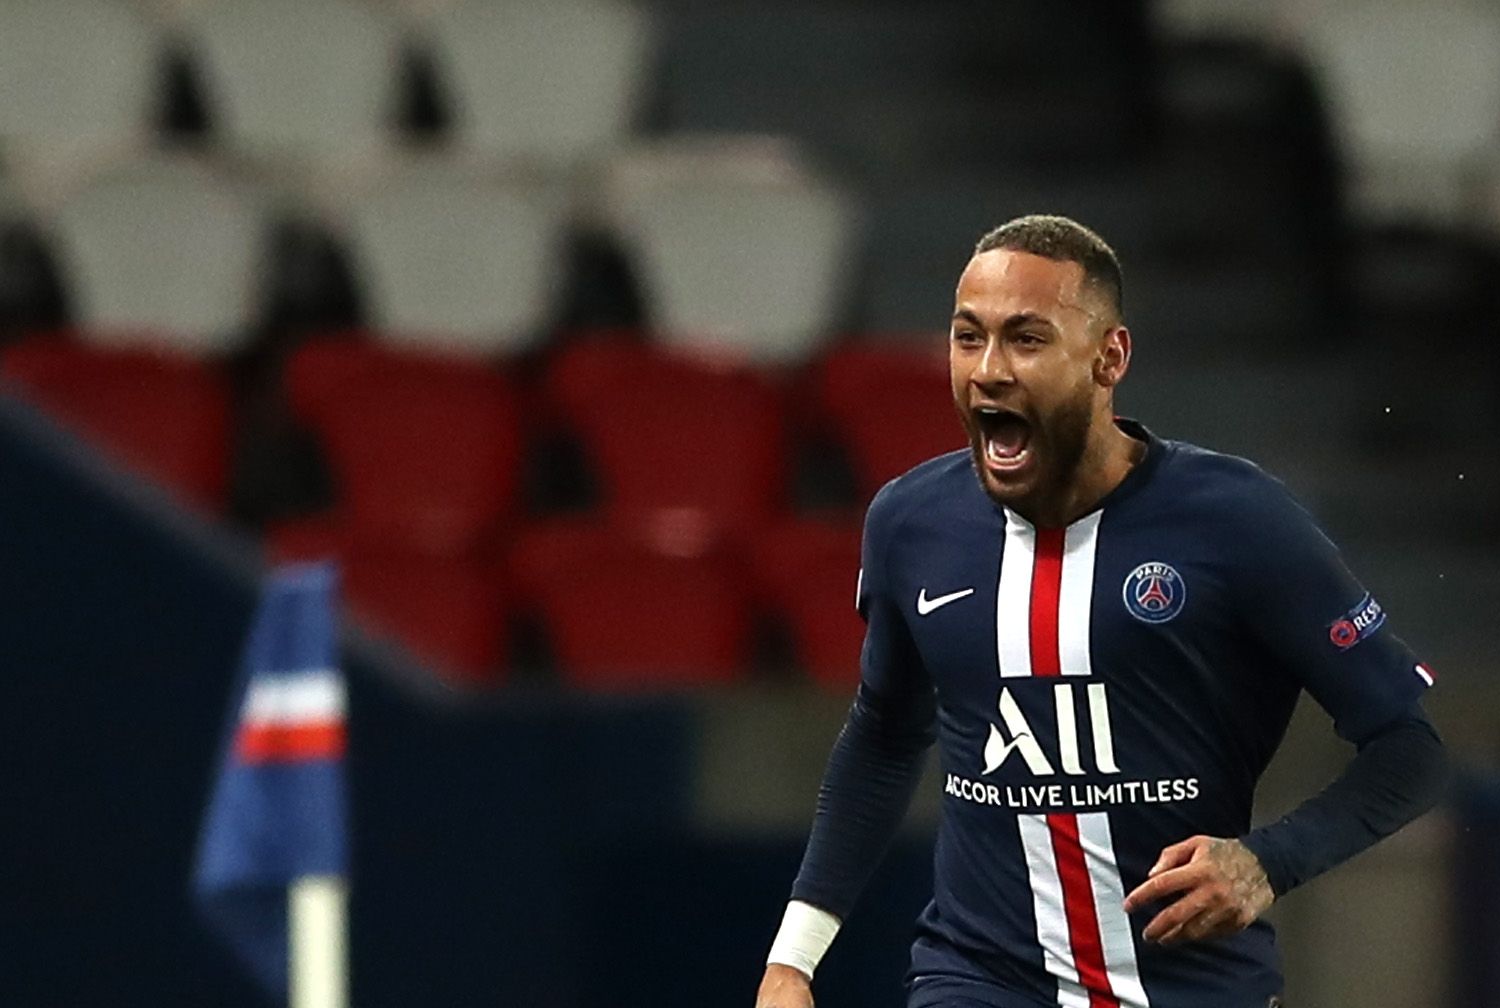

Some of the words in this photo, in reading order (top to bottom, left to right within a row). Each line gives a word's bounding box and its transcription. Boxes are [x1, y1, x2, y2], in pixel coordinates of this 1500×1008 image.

[945, 773, 1001, 806] ACCOR
[1008, 785, 1064, 807] LIVE
[1071, 778, 1200, 807] LIMITLESS
